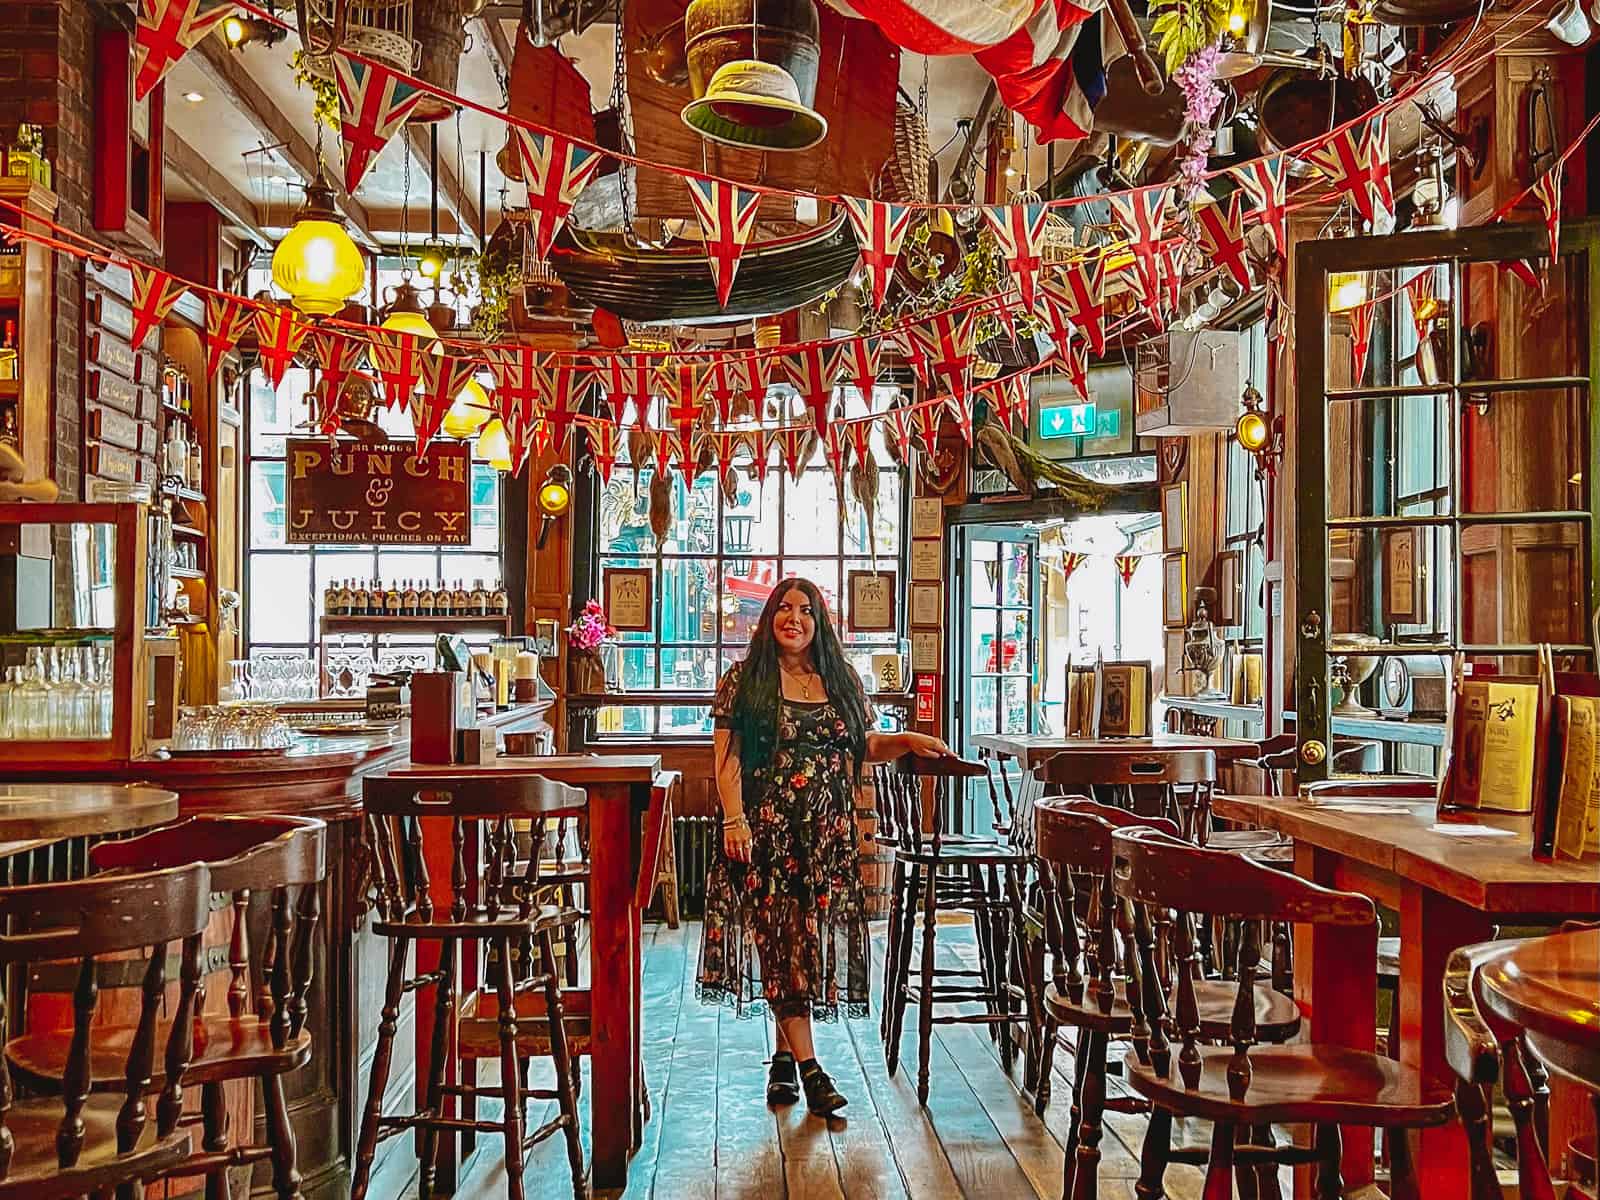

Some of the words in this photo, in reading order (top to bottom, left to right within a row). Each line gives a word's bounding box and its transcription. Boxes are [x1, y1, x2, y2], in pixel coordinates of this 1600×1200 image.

[293, 451, 465, 482] PUNCH
[366, 478, 393, 507] &
[292, 509, 465, 531] JUICY
[289, 532, 368, 541] EXCEPTIONAL
[372, 533, 421, 542] PUNCHES
[426, 534, 441, 542] ON
[446, 534, 467, 543] TAP
